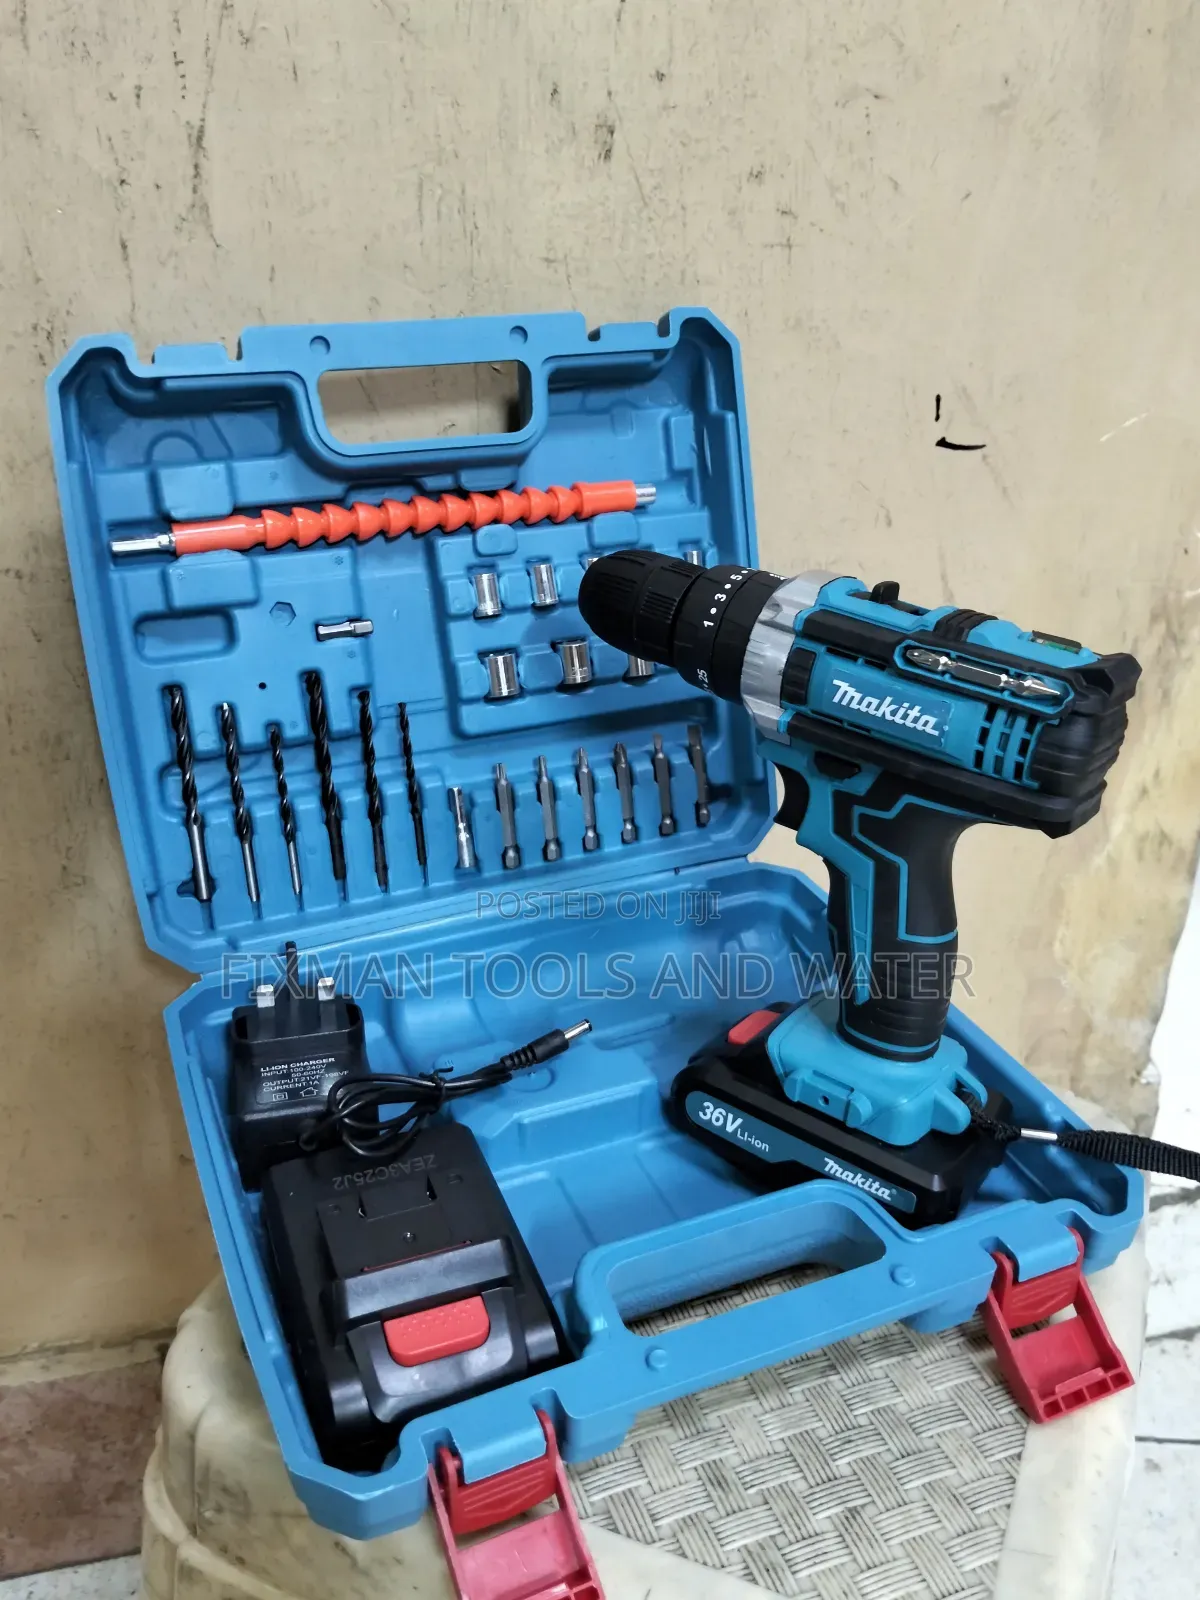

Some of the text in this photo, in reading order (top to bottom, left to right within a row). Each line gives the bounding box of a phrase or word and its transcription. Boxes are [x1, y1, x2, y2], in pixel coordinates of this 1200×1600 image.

[714, 593, 727, 602] 3
[730, 573, 743, 581] 5
[289, 1057, 336, 1068] CHARGER
[698, 1101, 743, 1133] 36V
